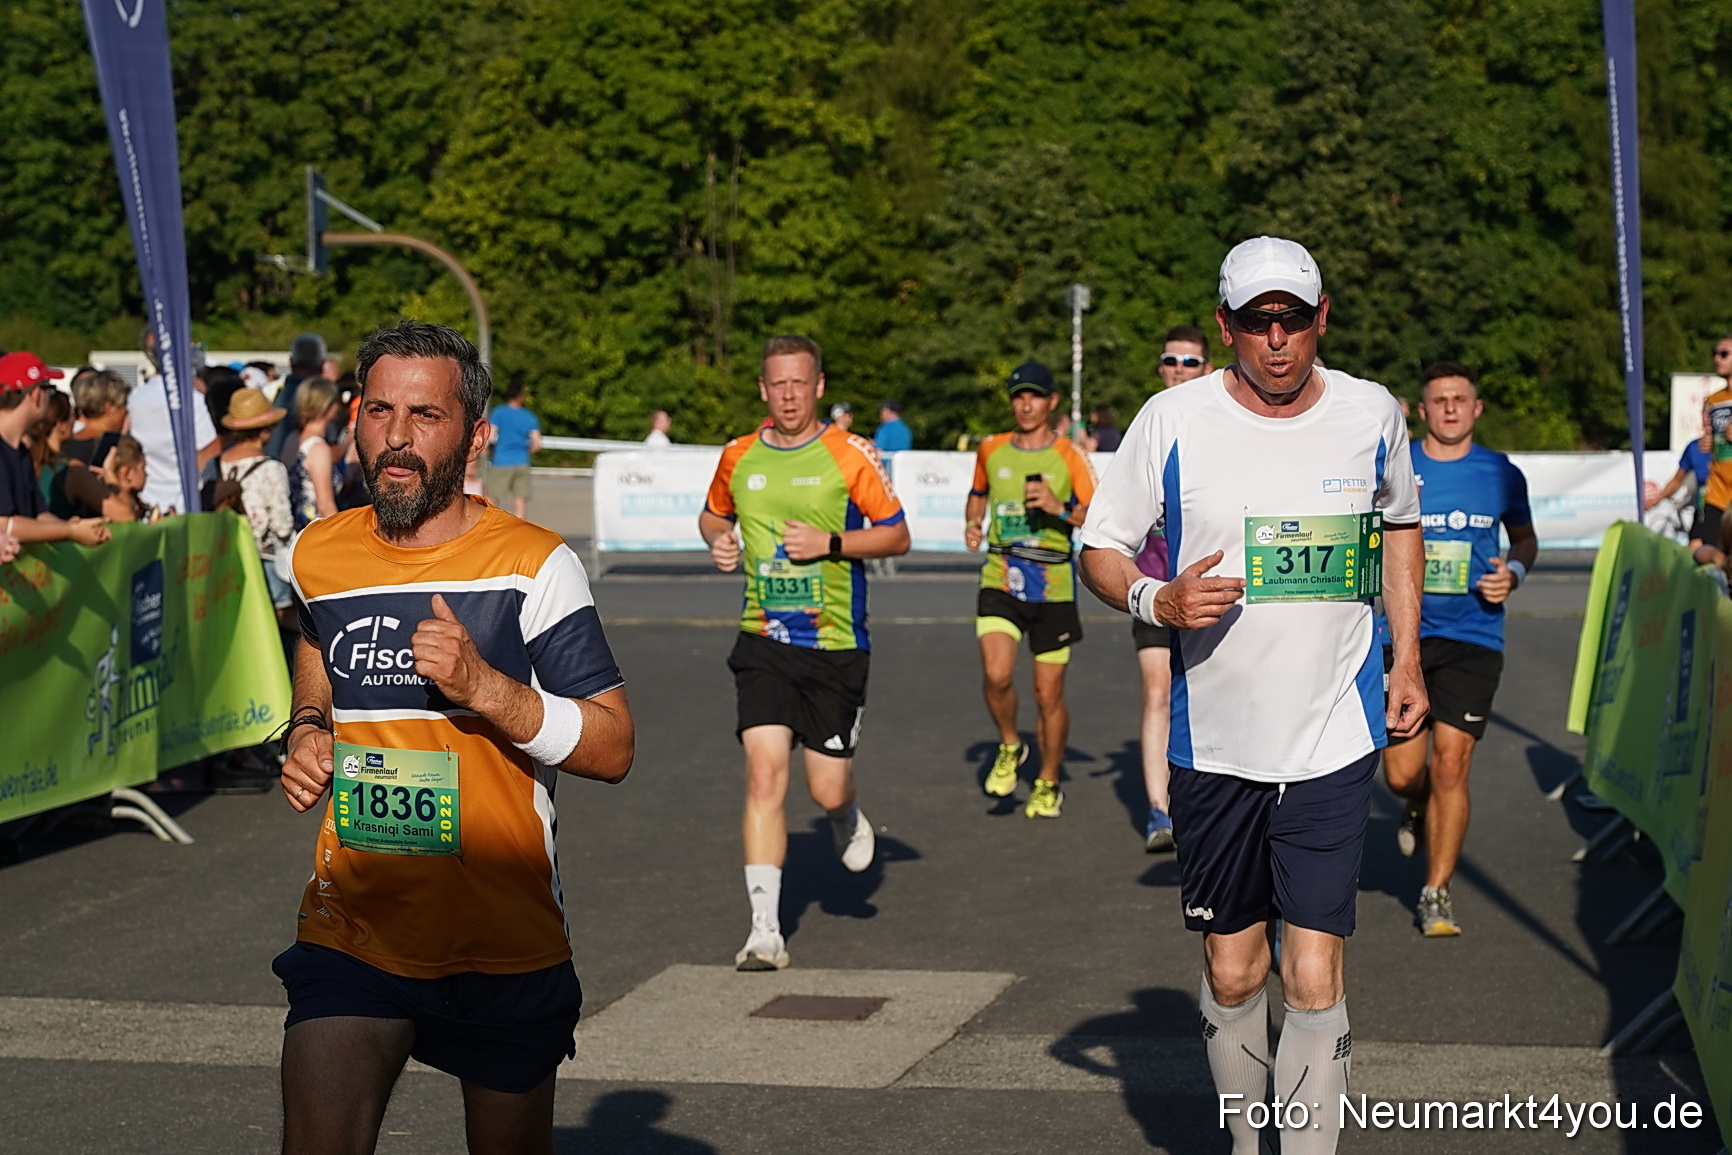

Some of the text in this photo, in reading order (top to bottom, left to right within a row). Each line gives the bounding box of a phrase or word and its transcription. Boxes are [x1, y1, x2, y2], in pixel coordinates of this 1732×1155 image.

[1342, 478, 1368, 487] PETTER
[1276, 531, 1313, 540] Firmenlauf
[1252, 556, 1263, 586] RUN
[1275, 546, 1335, 574] 317
[1345, 548, 1355, 588] 2022
[1425, 559, 1453, 576] 34
[767, 577, 809, 594] 1331
[1263, 575, 1346, 585] Laubmann Christian
[349, 642, 415, 670] Fisc
[360, 766, 399, 776] Firmenlauf
[339, 791, 350, 827] RUN
[351, 781, 437, 822] 1836
[353, 818, 434, 838] Krasniqi Sami
[440, 794, 453, 843] 2022
